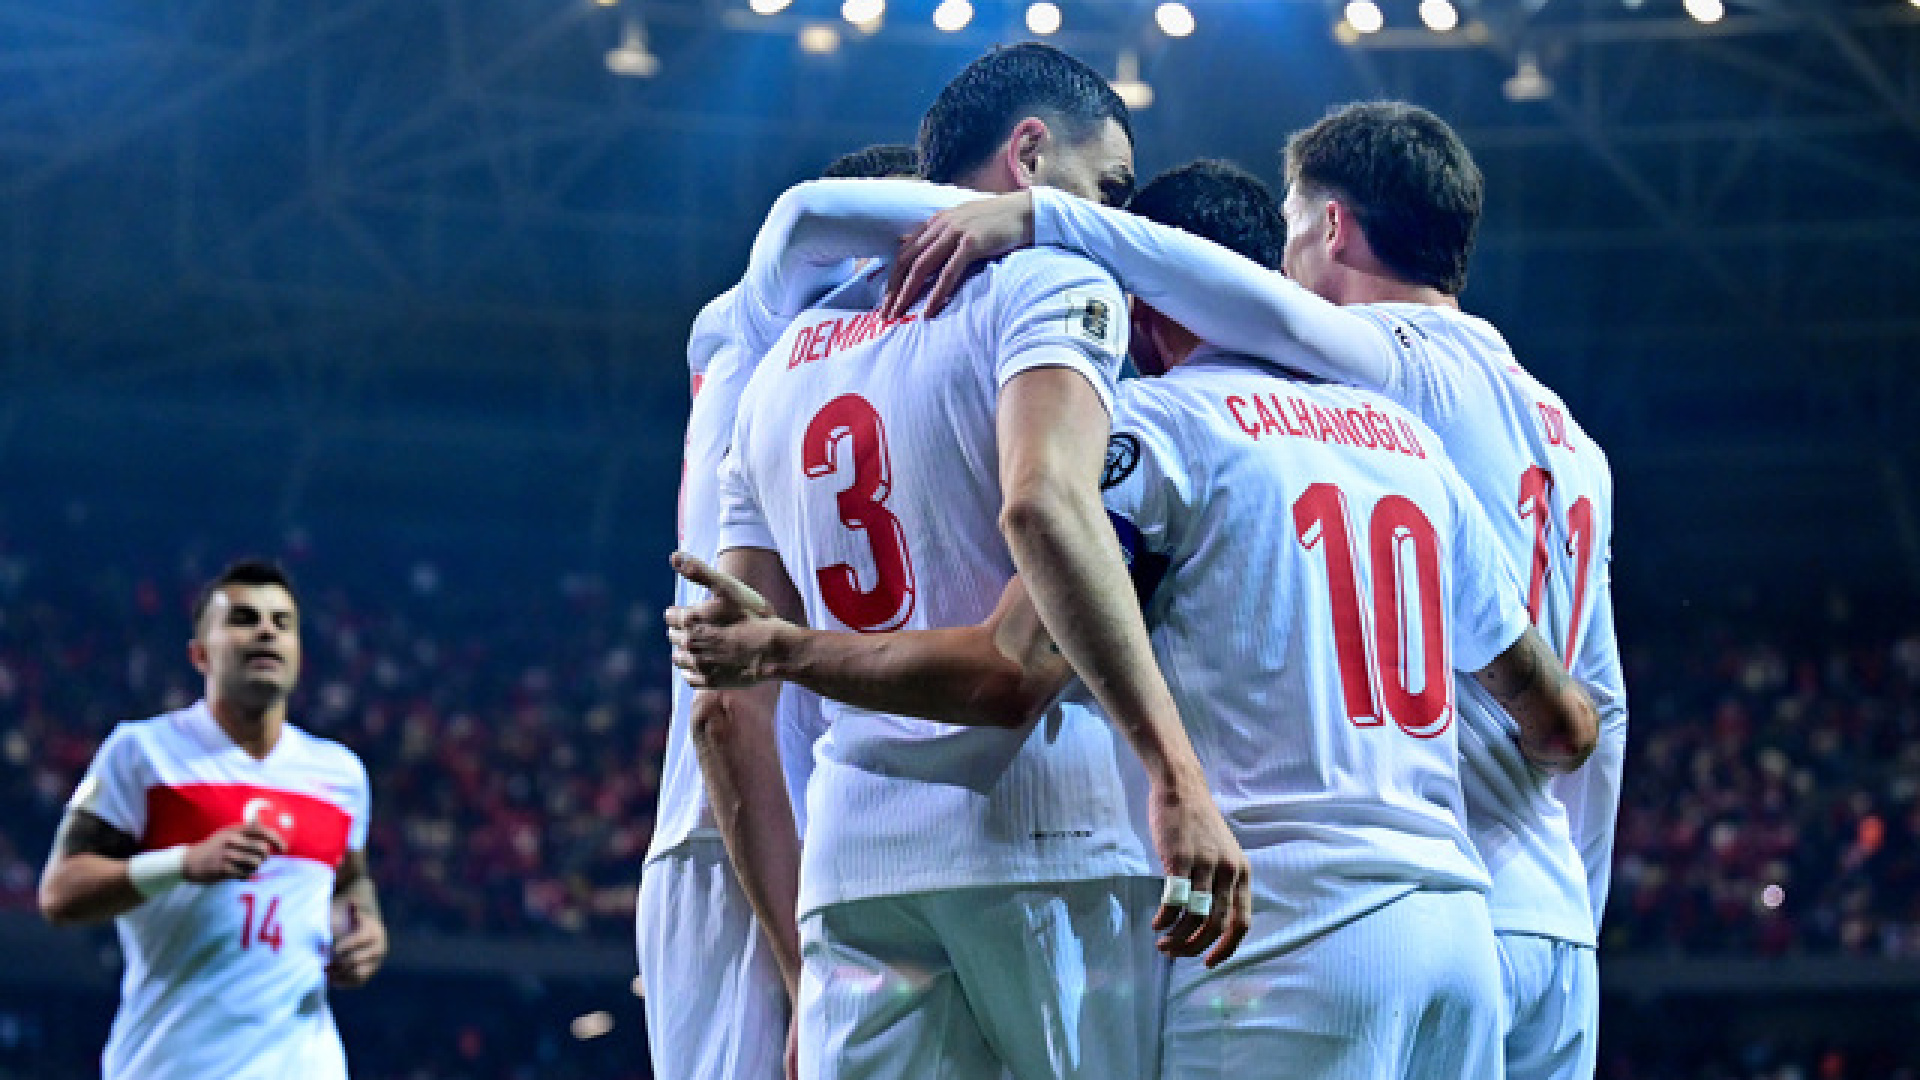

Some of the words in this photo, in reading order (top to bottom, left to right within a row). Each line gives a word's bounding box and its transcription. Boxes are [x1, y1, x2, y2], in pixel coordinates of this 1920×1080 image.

[786, 305, 918, 371] DEMIR
[1225, 392, 1427, 459] ÇALHANOĞLU
[801, 392, 916, 634] 3
[1517, 462, 1595, 674] 11
[1290, 482, 1453, 739] 10
[237, 892, 284, 953] 14
